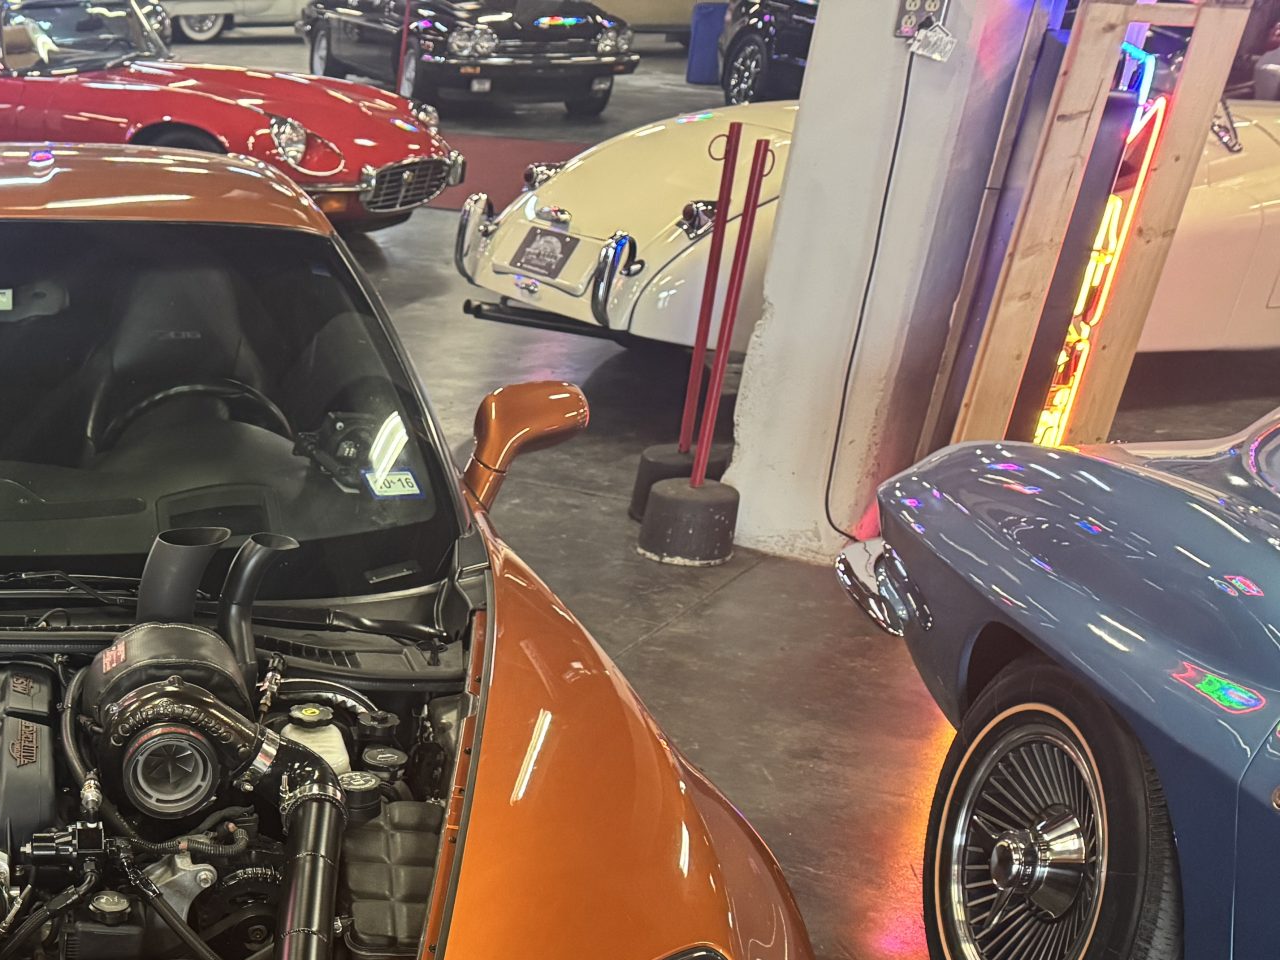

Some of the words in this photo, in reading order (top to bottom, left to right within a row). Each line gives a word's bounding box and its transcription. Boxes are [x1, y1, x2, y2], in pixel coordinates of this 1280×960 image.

[397, 477, 414, 489] 16
[110, 706, 154, 747] COMP
[173, 704, 234, 744] TURBO
